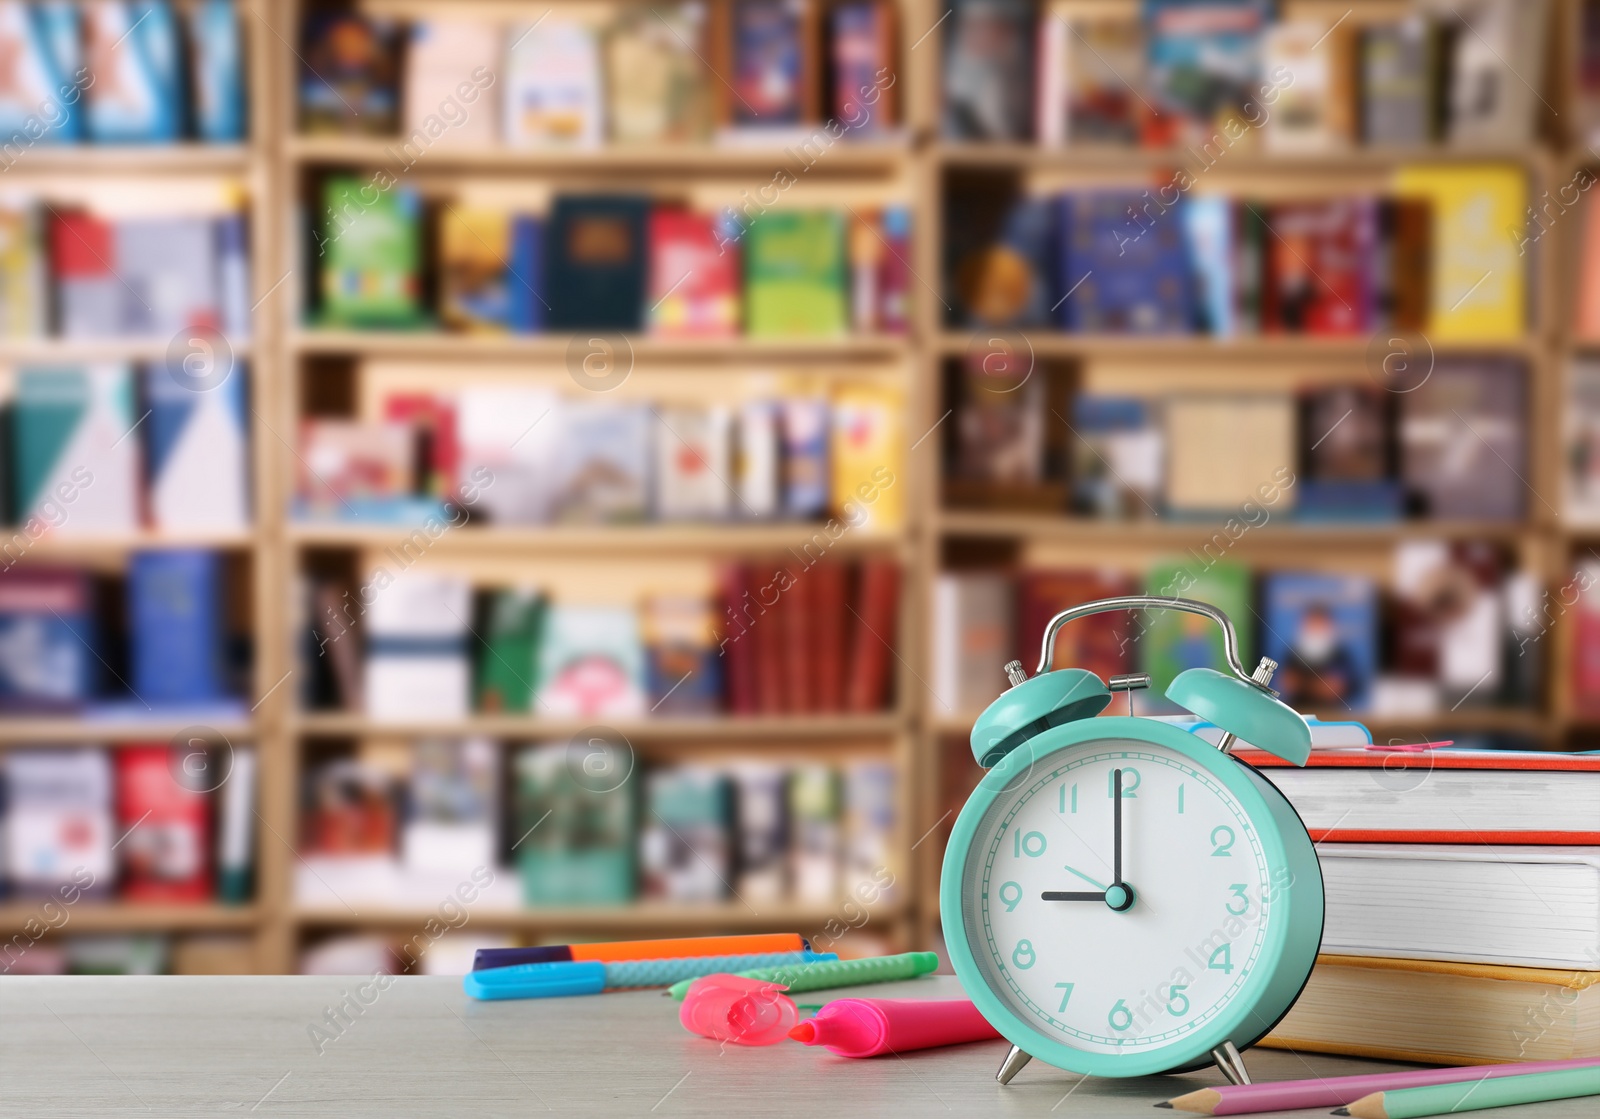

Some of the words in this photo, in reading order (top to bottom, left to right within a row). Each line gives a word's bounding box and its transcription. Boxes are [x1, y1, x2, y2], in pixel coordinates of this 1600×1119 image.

[1108, 766, 1141, 798] 12
[1059, 783, 1077, 813] 11
[1178, 783, 1184, 814] 1
[1014, 828, 1047, 858] 10
[1210, 825, 1235, 857] 2
[999, 881, 1022, 912] 9
[1226, 884, 1249, 915] 3
[1012, 939, 1036, 970] 8
[1208, 943, 1234, 974] 4
[1054, 982, 1075, 1013] 7
[1166, 985, 1190, 1017] 5
[1108, 999, 1133, 1031] 6
